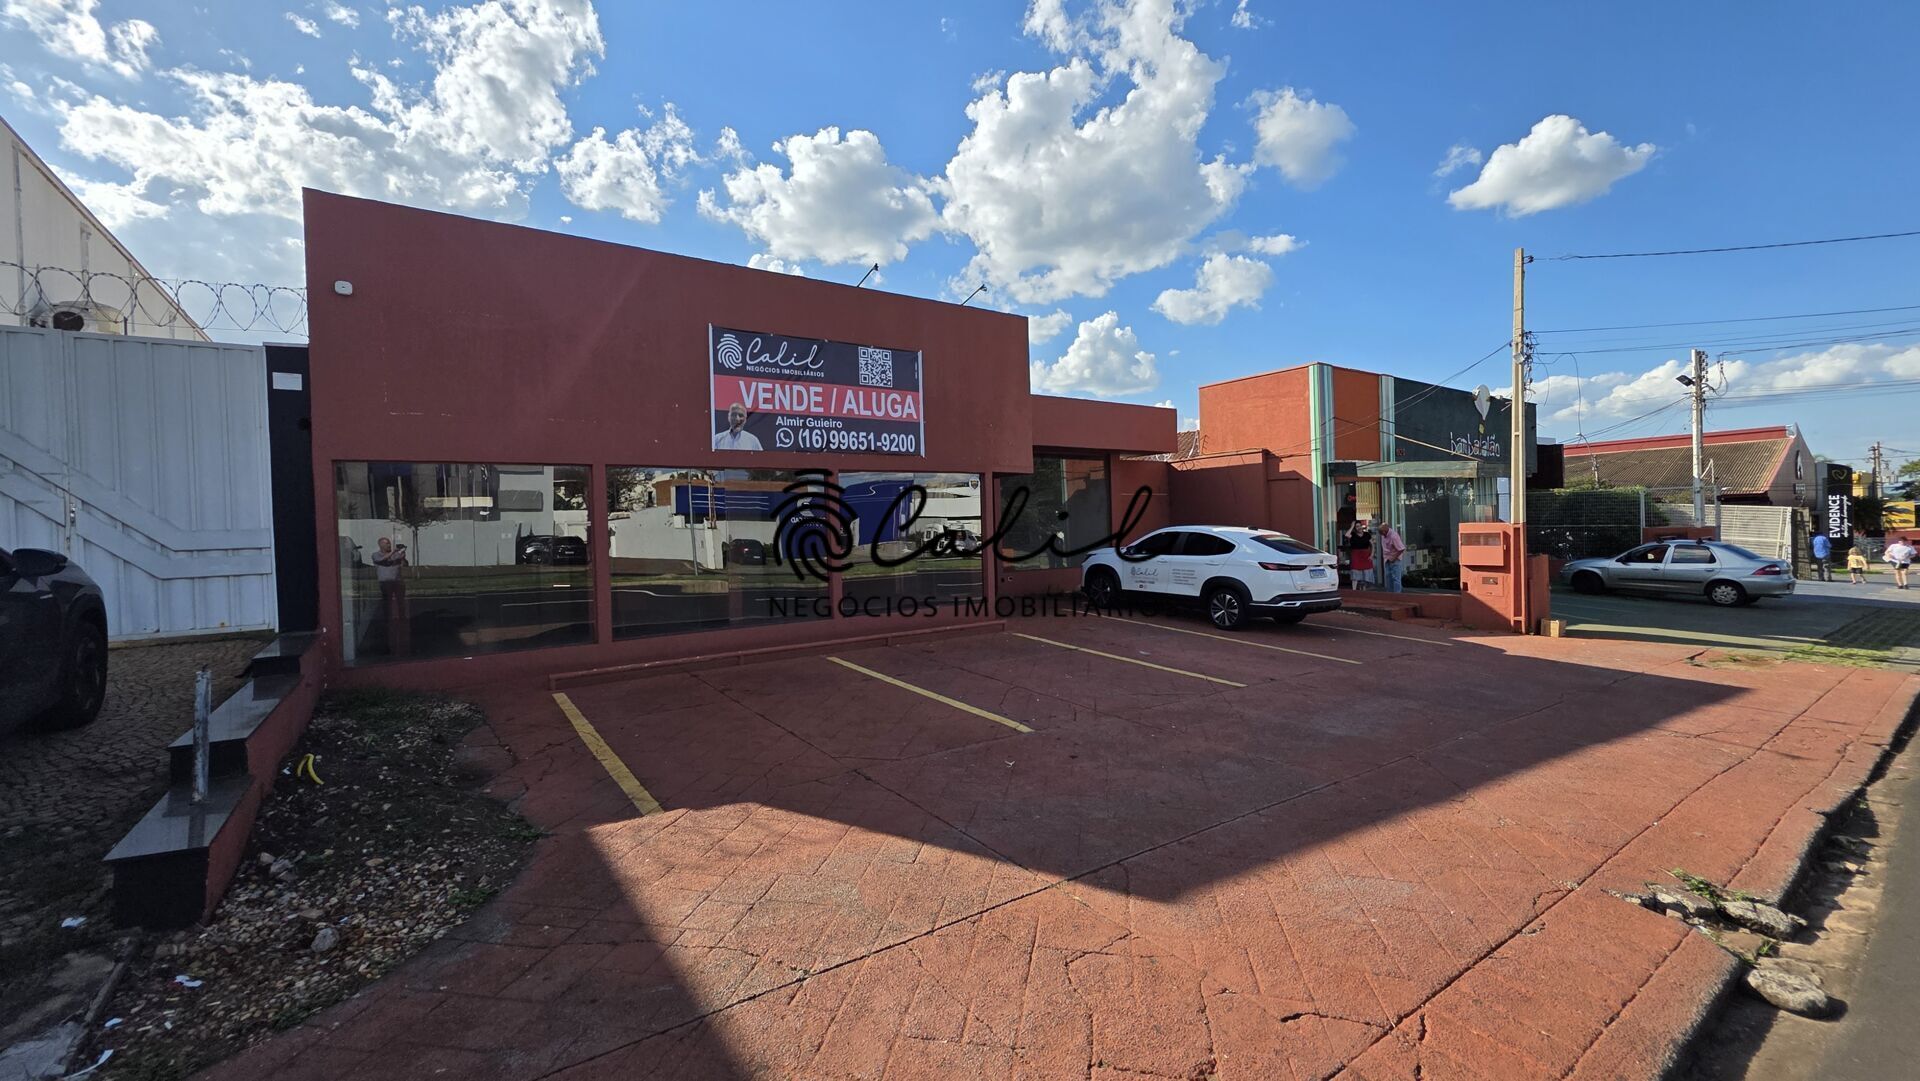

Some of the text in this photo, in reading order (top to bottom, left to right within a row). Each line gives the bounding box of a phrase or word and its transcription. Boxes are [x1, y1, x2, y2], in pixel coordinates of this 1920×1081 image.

[746, 337, 824, 369] Calil
[746, 365, 825, 378] NEGÓCIOS IMOBILIÁRIOS
[739, 380, 918, 419] VENDE / ALUGA
[775, 416, 843, 429] Almir Guieiro
[1828, 494, 1841, 538] EVIDENCE
